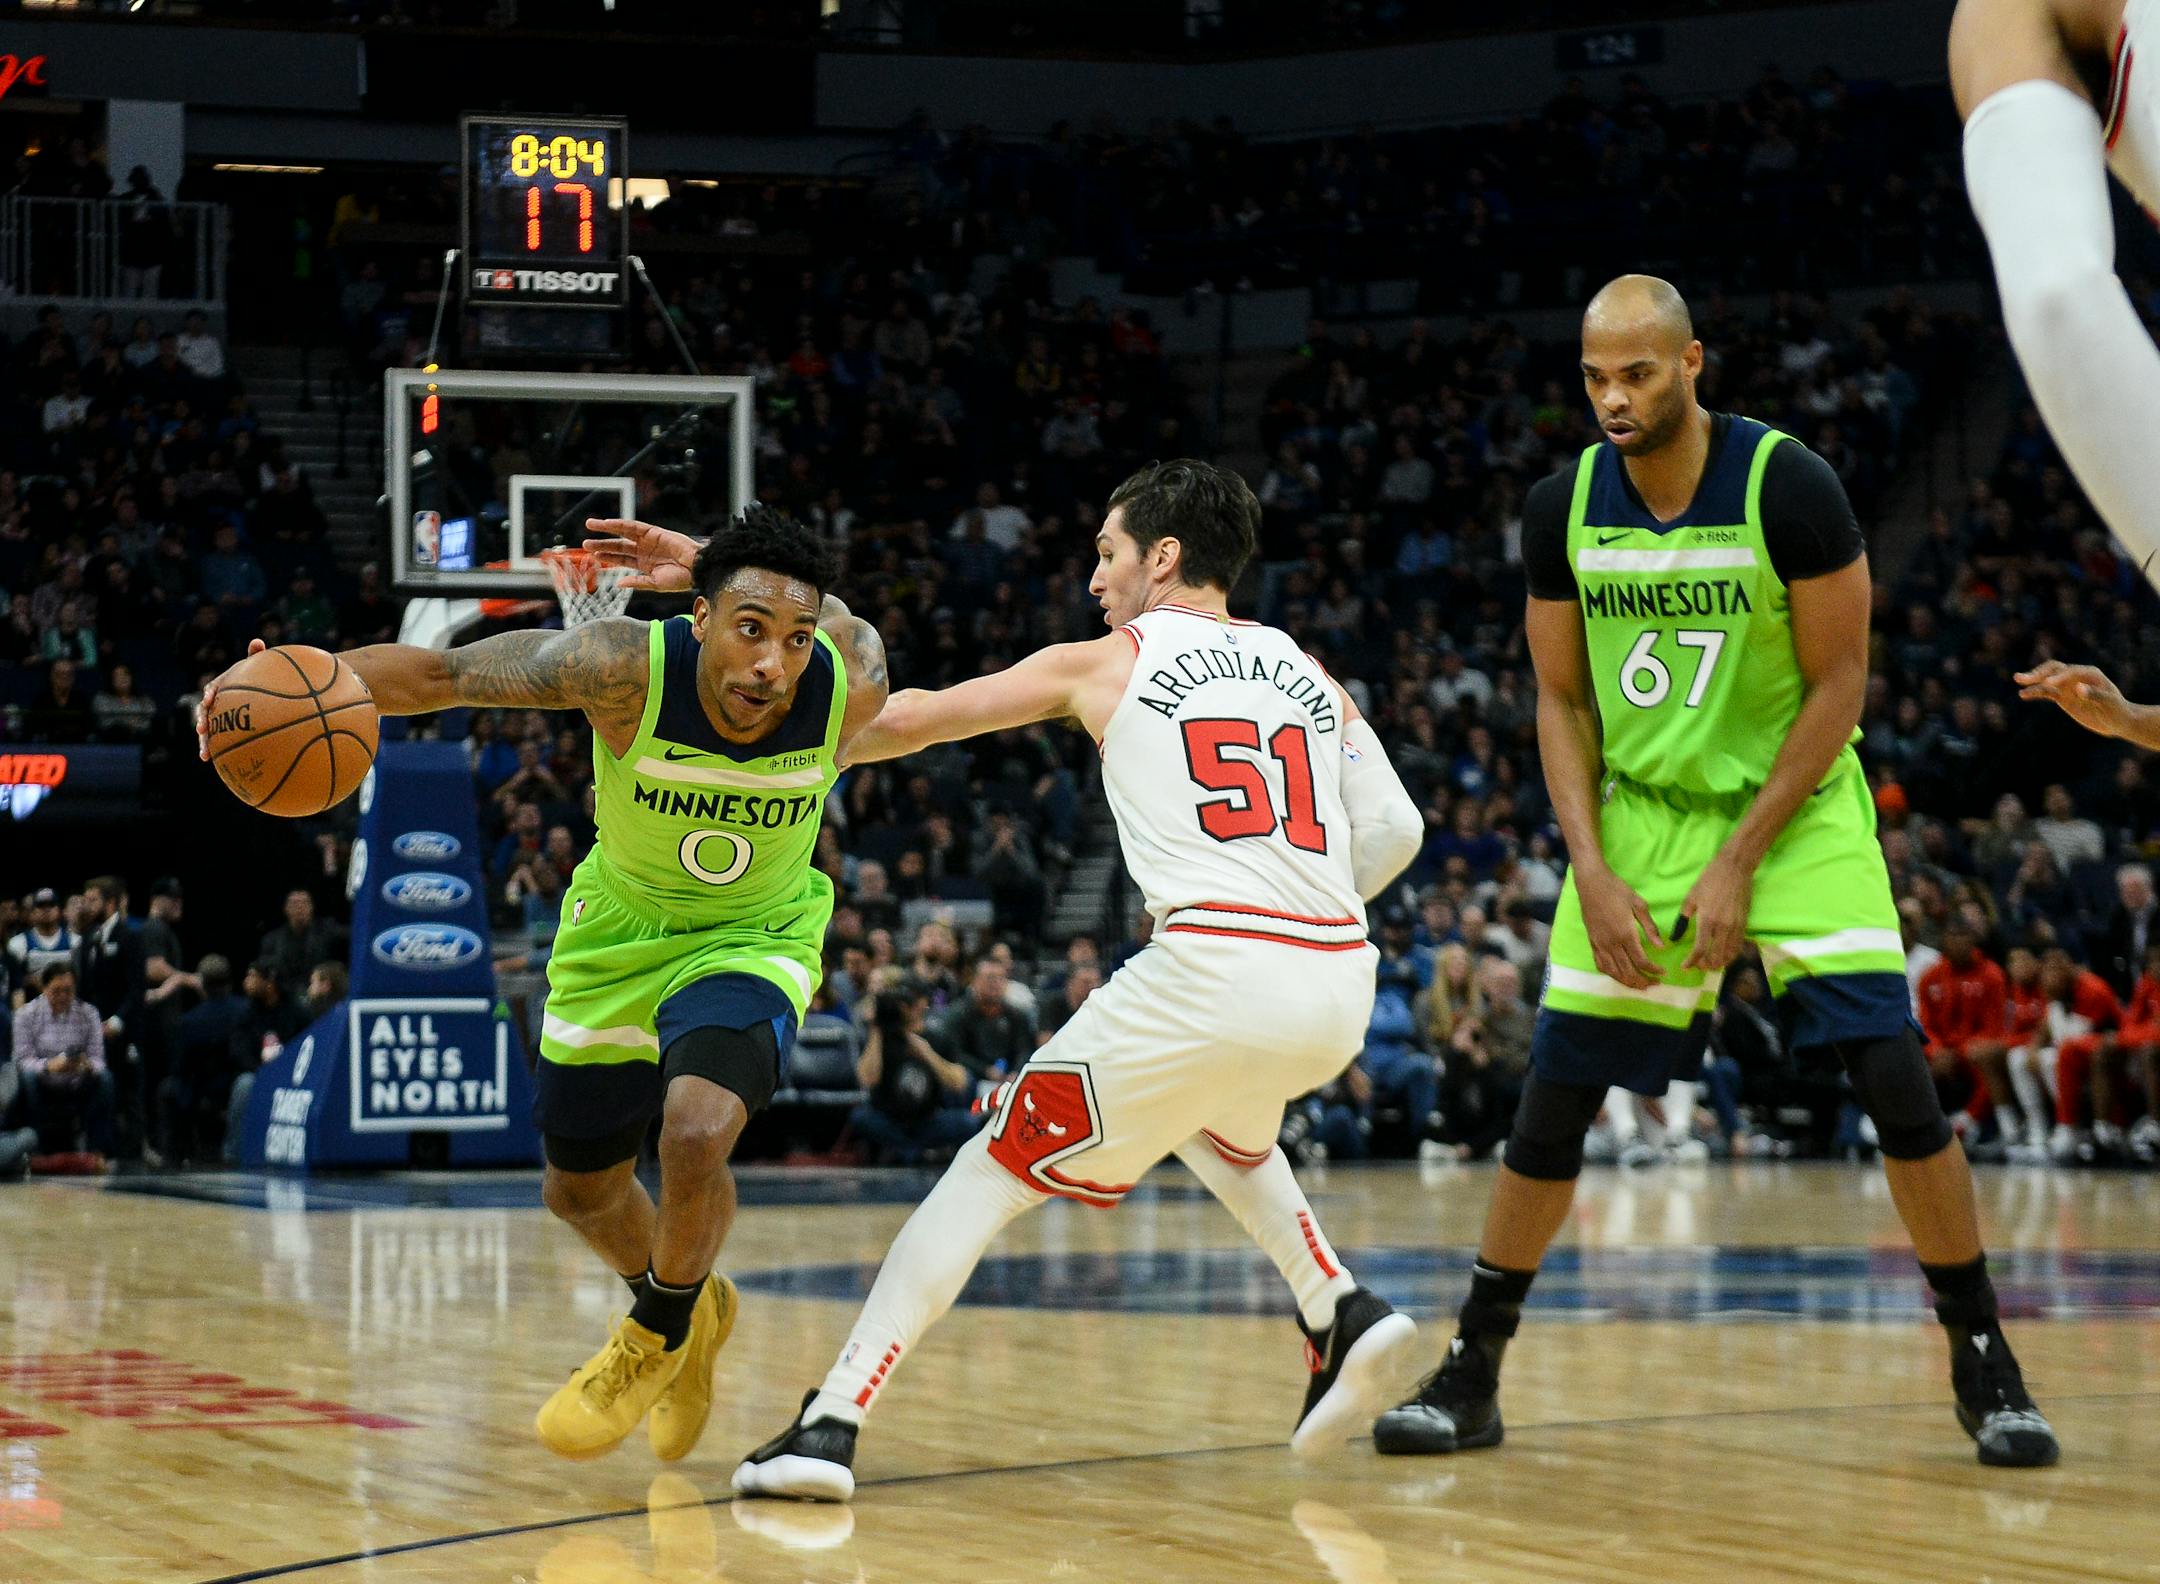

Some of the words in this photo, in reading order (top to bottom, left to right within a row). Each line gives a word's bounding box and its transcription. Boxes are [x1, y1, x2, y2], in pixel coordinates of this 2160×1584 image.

[511, 134, 605, 179] 8:04
[527, 182, 593, 252] 17
[514, 270, 620, 292] TISSOT
[1707, 530, 1738, 542] fitbit
[1584, 578, 1753, 618] MINNESOTA
[1619, 628, 1728, 708] 67
[1137, 648, 1336, 734] ARCIDIACONO
[208, 703, 251, 738] DING
[782, 752, 817, 768] fitbit
[633, 779, 818, 829] MINNESOTA
[1179, 717, 1328, 856] 51
[677, 828, 754, 887] 0
[397, 874, 458, 904] Ford
[388, 926, 466, 963] Ford
[369, 1014, 439, 1047] ALL
[369, 1046, 464, 1080] EYES
[369, 1080, 508, 1113] NORTH
